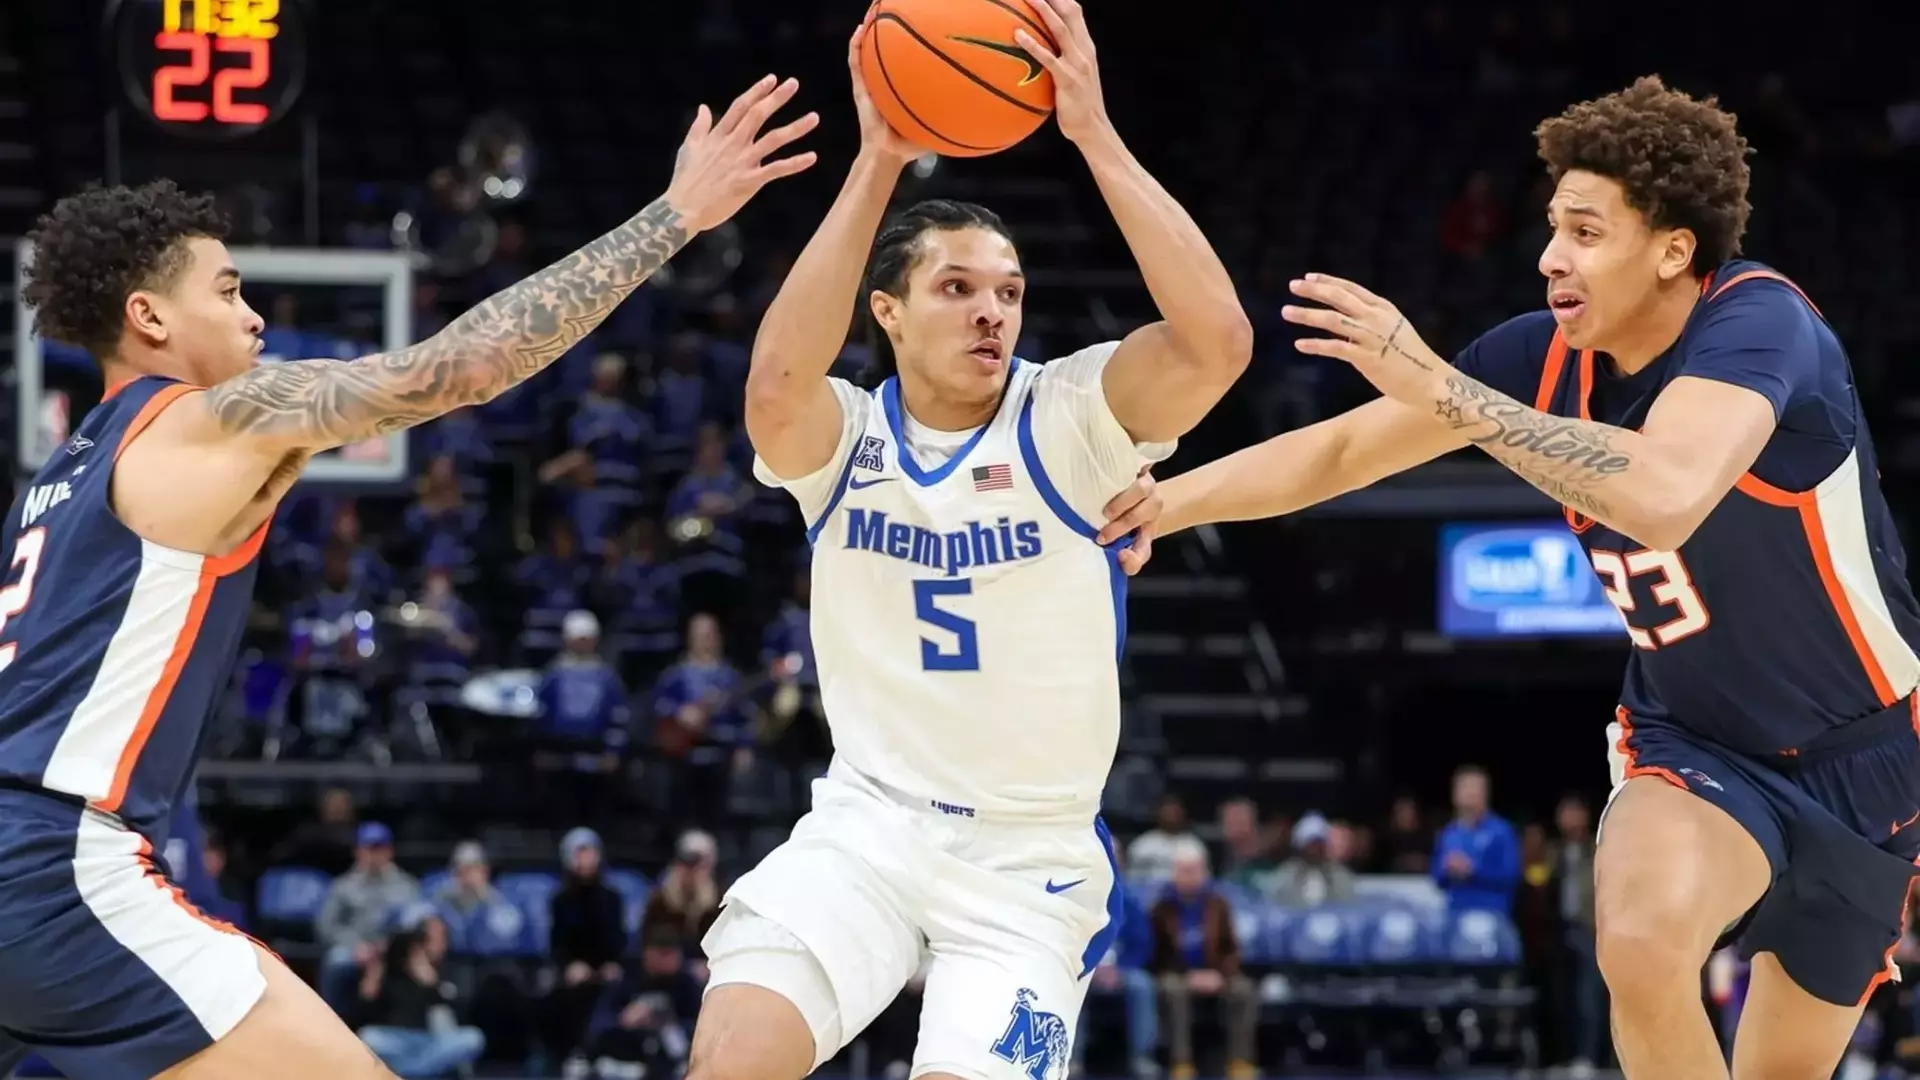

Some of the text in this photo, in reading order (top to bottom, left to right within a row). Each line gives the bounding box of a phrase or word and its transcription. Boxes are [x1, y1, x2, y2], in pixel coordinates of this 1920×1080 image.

[154, 30, 270, 124] 22
[586, 200, 684, 263] MADE
[855, 435, 885, 472] A
[843, 507, 1043, 577] Memphis
[912, 577, 980, 672] 5
[1590, 546, 1710, 651] 23
